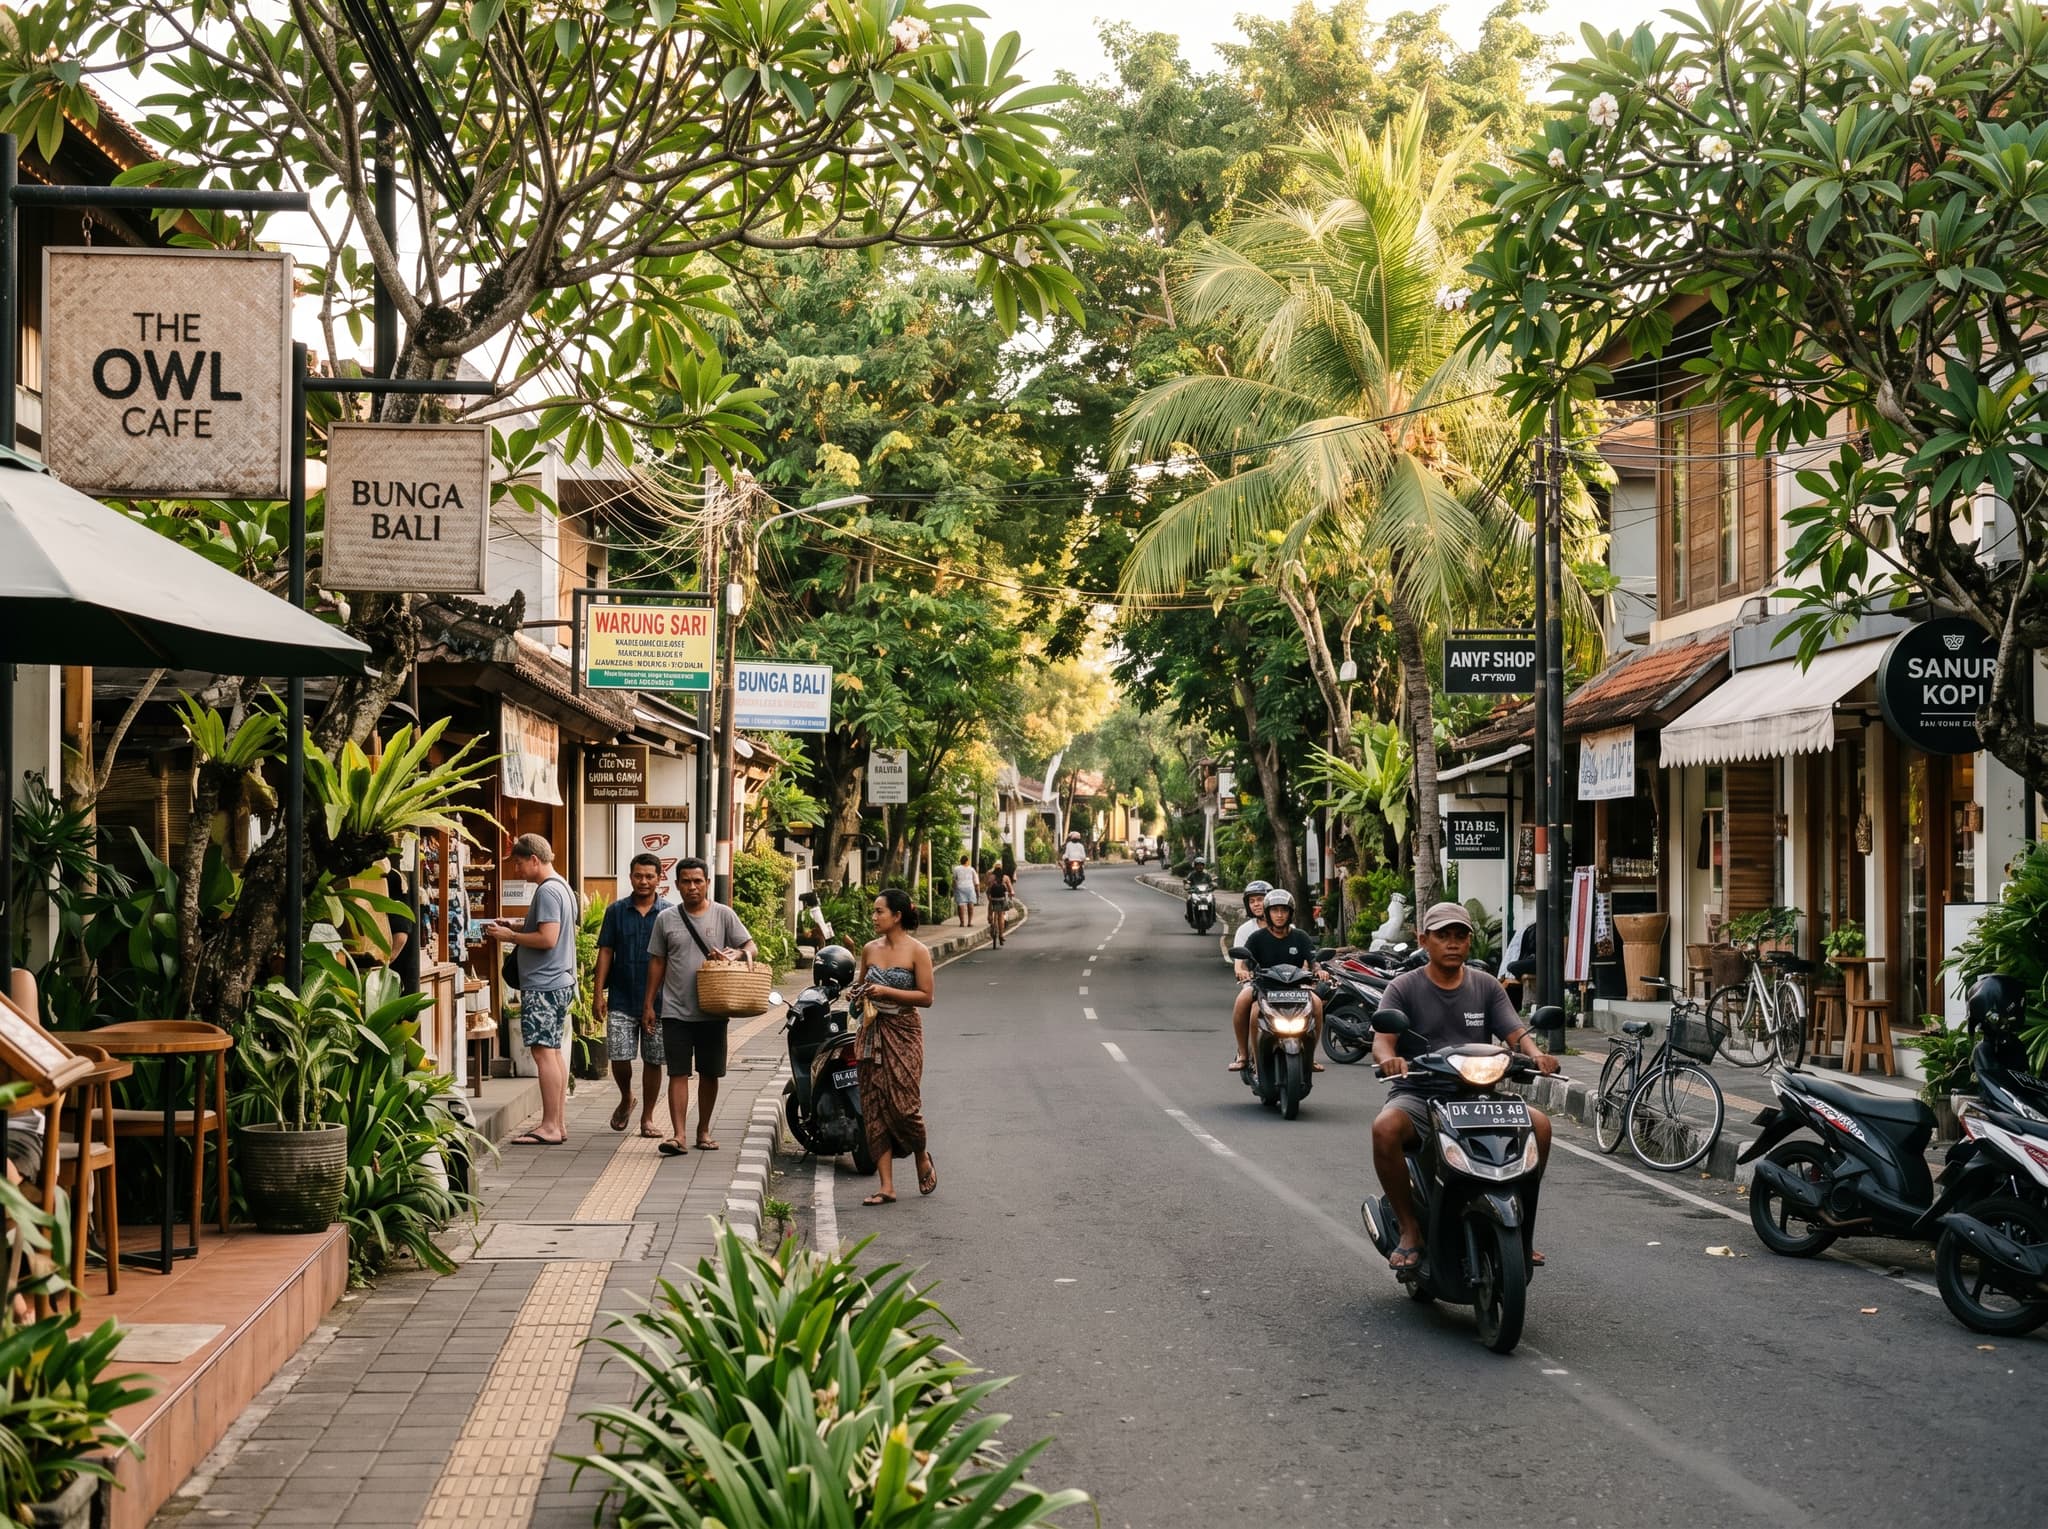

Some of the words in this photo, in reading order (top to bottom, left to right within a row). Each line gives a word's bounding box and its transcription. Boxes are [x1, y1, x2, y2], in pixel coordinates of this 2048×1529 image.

[132, 312, 201, 342] THE
[92, 348, 243, 401] OWL
[121, 406, 213, 438] CAFE
[351, 480, 465, 509] BUNGA
[371, 513, 441, 541] BALI
[595, 612, 665, 635] WARUNG
[670, 614, 707, 636] SARI
[1493, 651, 1536, 668] SHOP
[1907, 657, 1998, 679] SANUR
[738, 671, 788, 693] BUNGA
[792, 673, 826, 695] BALI
[1922, 684, 1984, 705] KOPI
[1452, 1105, 1469, 1116] DK
[1474, 1104, 1503, 1115] 4713
[1507, 1104, 1524, 1115] AB
